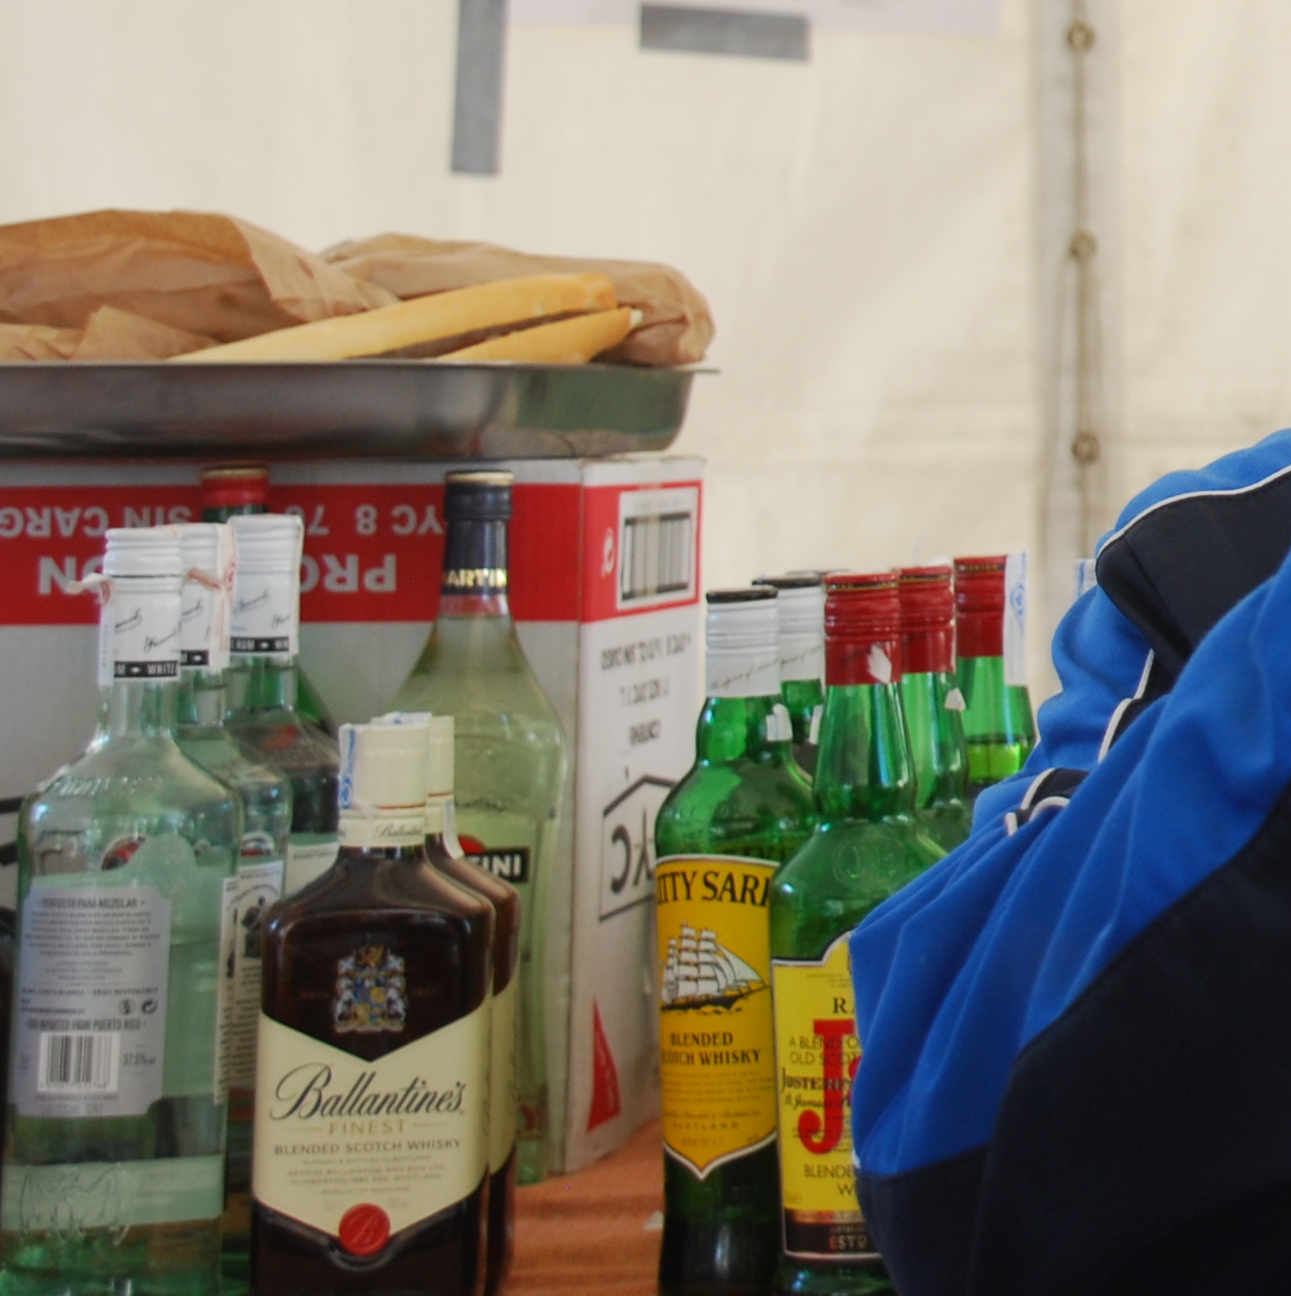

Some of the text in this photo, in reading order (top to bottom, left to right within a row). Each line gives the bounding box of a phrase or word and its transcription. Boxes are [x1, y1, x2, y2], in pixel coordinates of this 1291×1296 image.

[0, 505, 109, 538] CARG
[698, 1048, 761, 1065] WHISKY
[269, 1062, 467, 1121] Ballantine's
[328, 1118, 408, 1136] FINEST
[275, 1138, 462, 1156] BLENDED SCOTCH WHISKY
[804, 1164, 856, 1179] BLENDE
